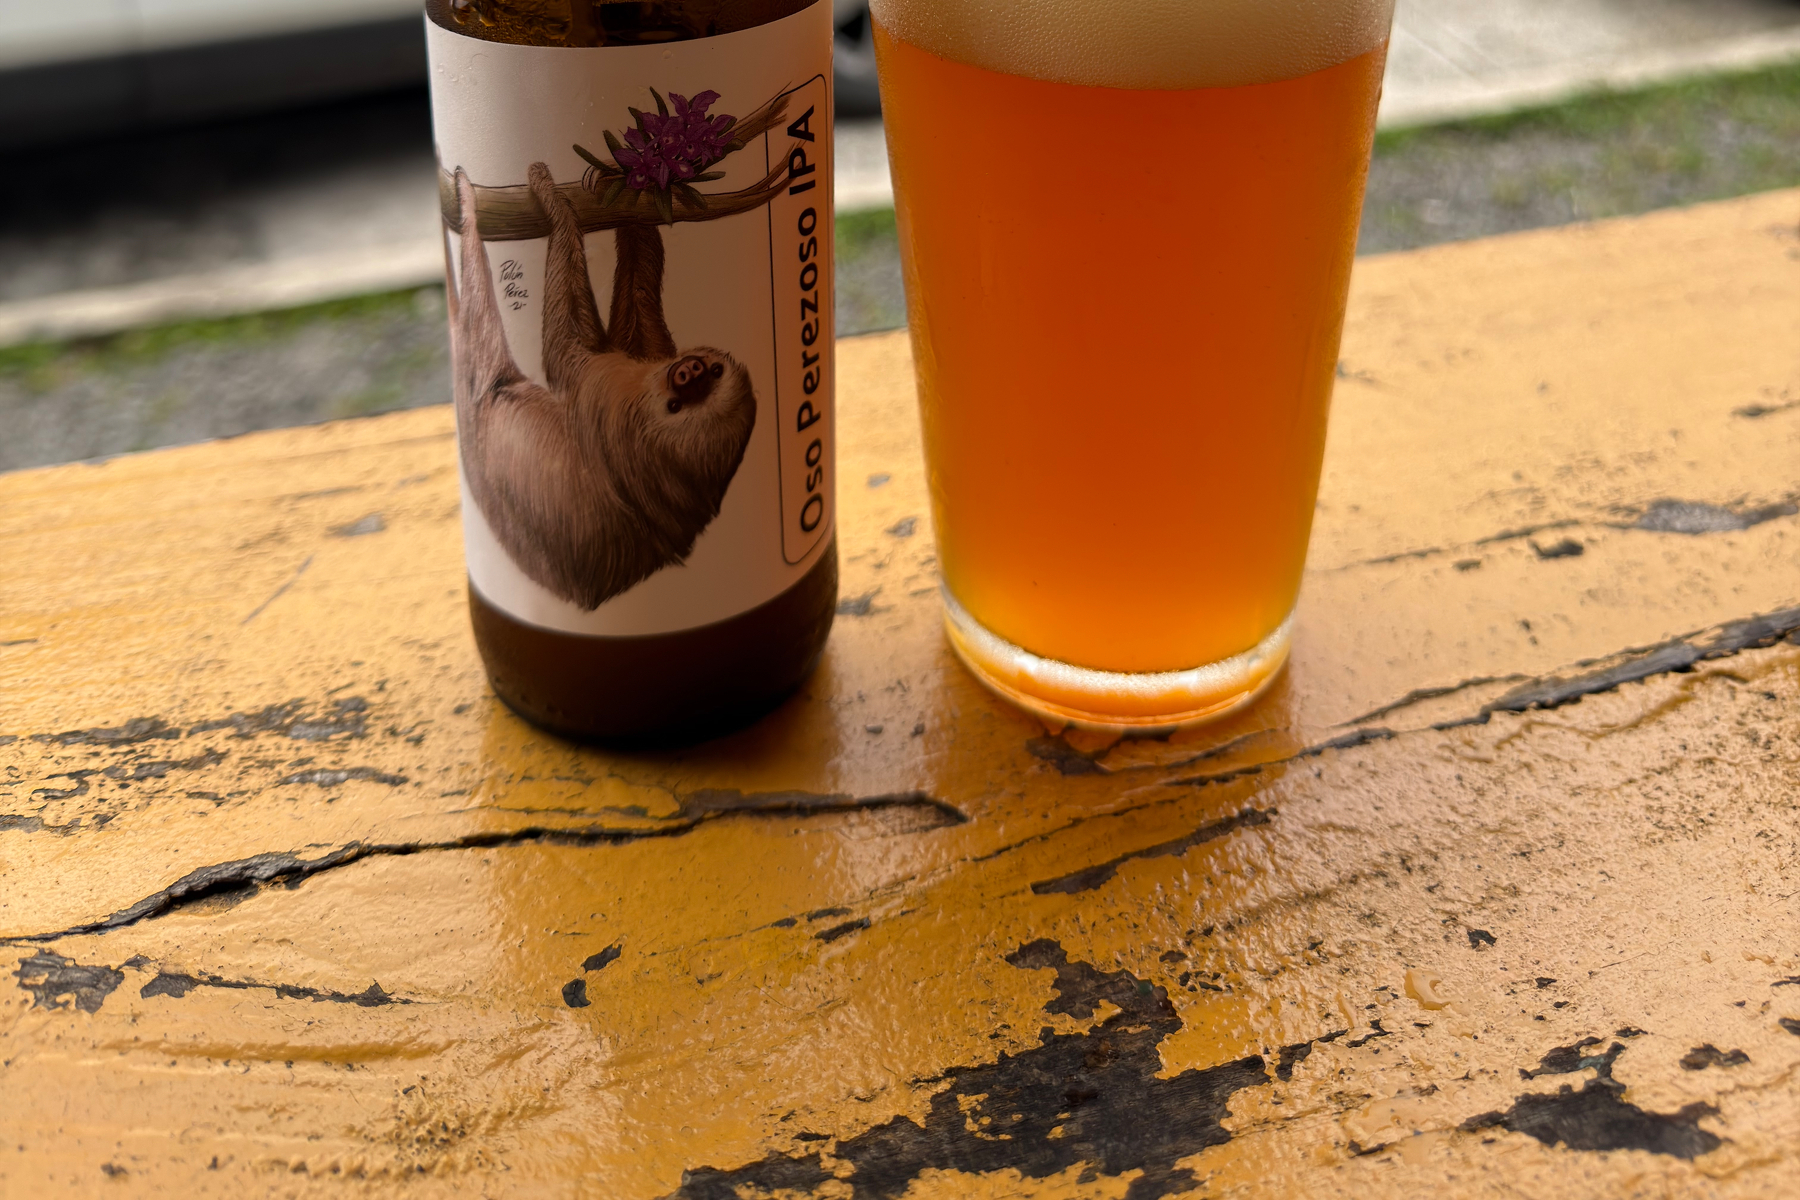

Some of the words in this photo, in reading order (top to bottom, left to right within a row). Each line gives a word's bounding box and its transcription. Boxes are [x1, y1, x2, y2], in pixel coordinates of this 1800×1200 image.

[786, 104, 817, 196] IPA
[796, 205, 822, 433] Perezoso
[800, 437, 824, 533] Oso
